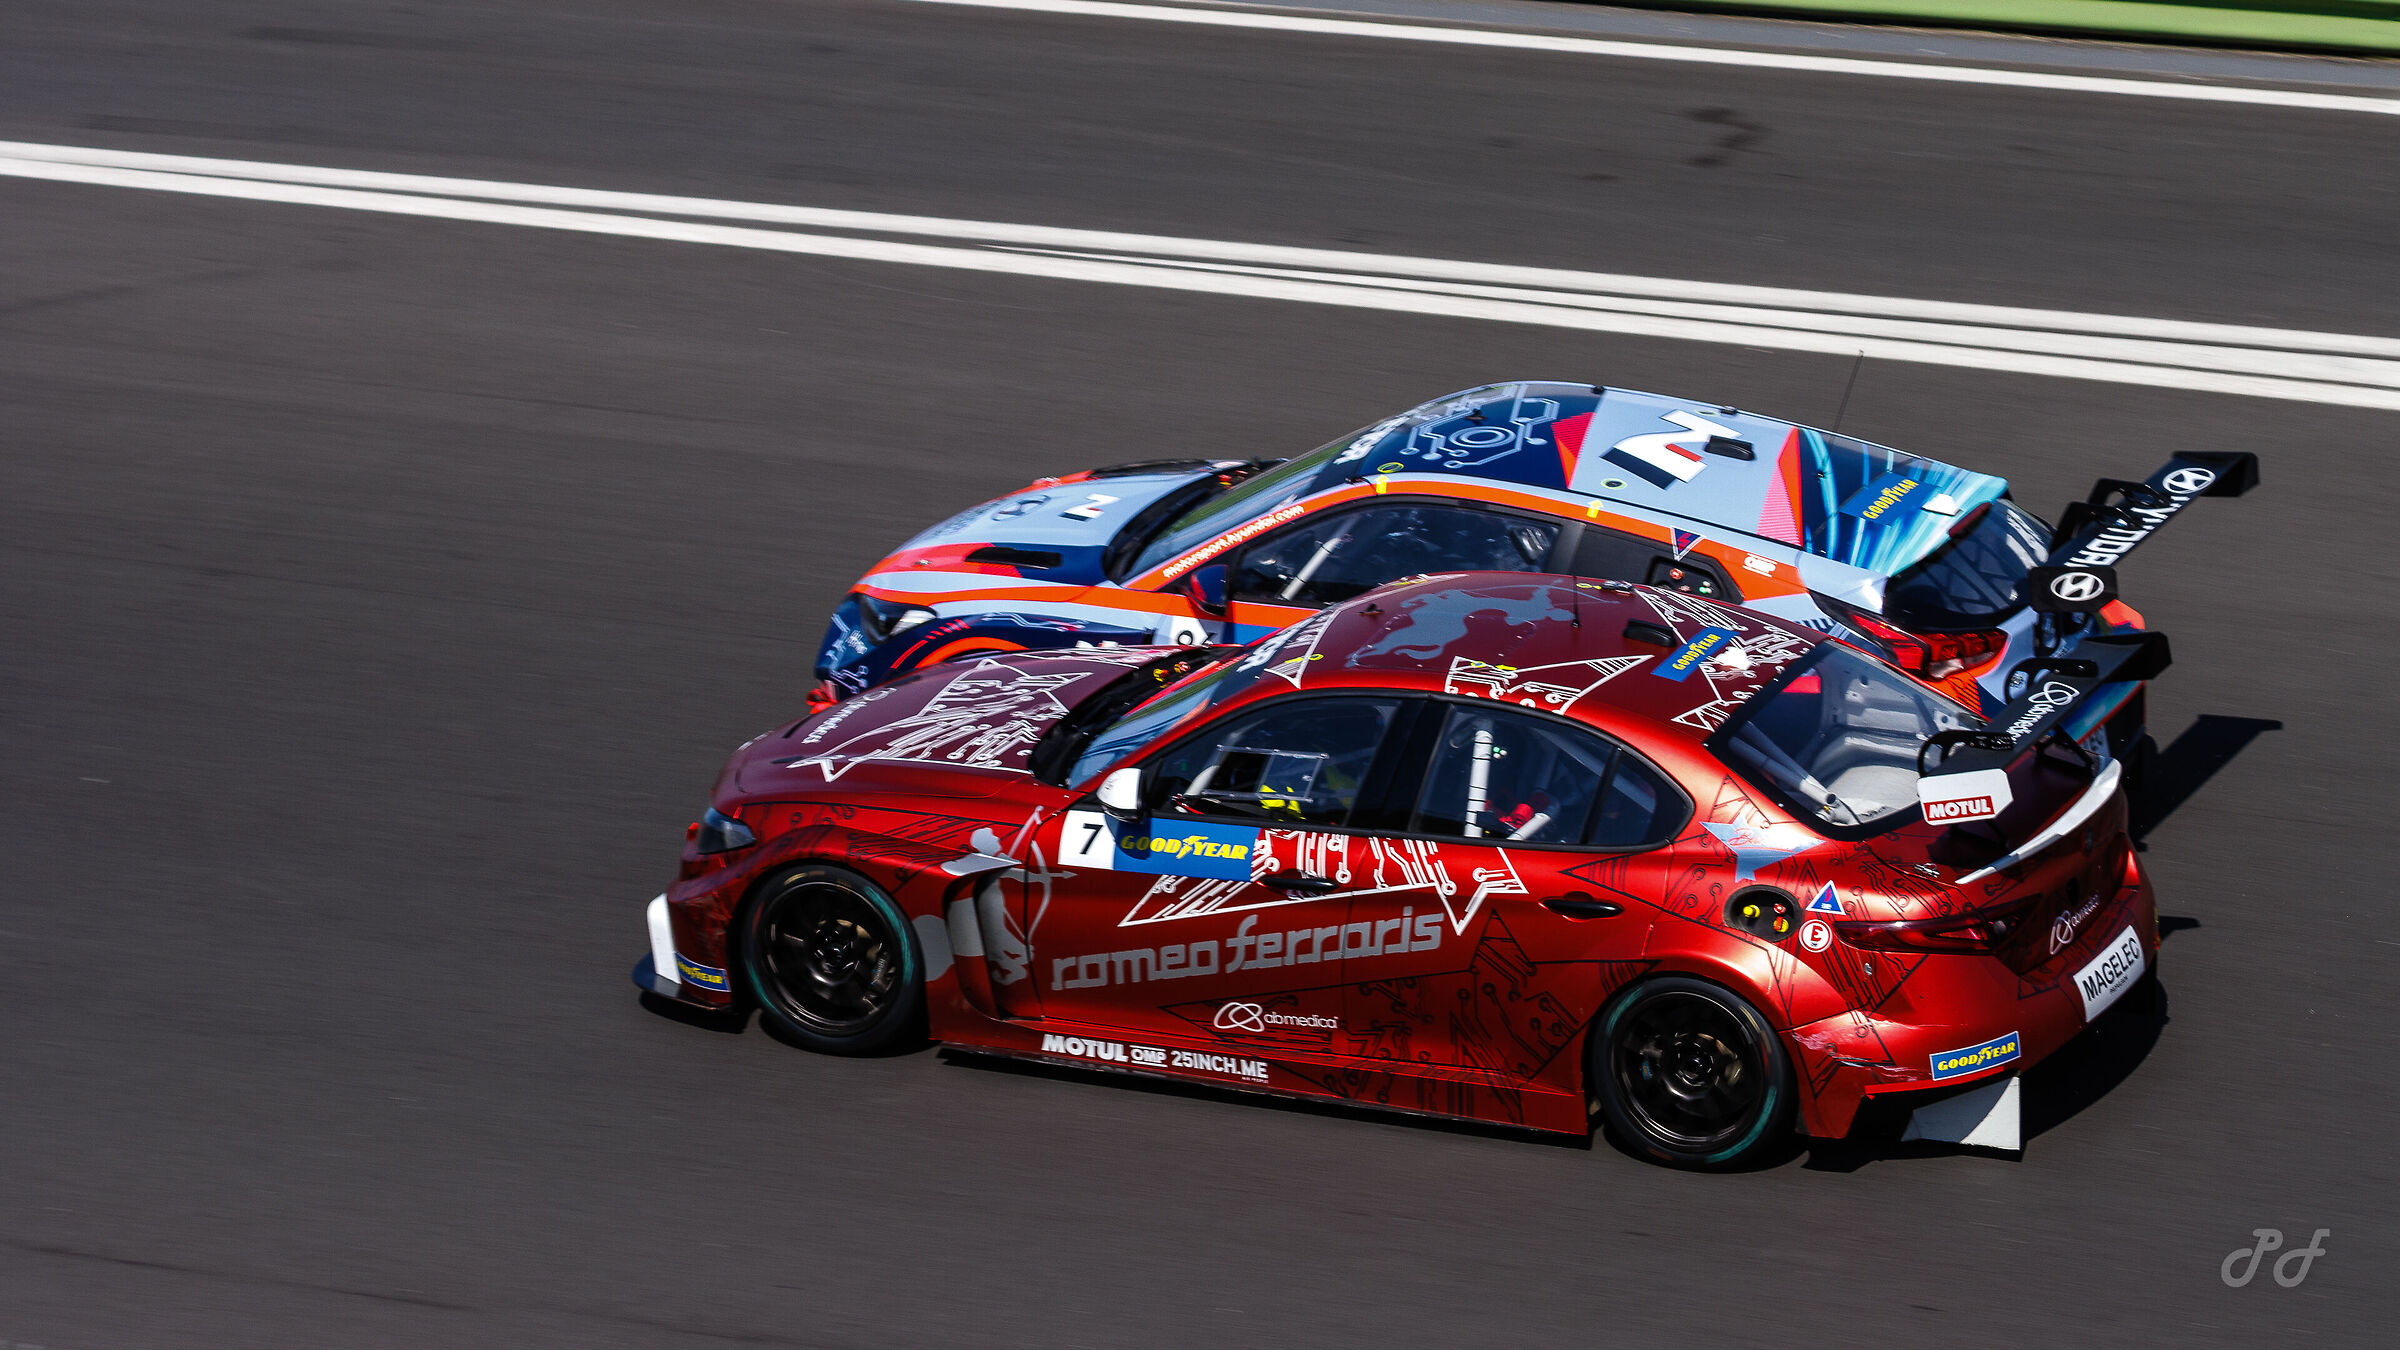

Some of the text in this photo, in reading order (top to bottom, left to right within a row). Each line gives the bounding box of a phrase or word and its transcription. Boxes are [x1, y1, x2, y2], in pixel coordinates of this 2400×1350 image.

[1863, 479, 1919, 519] GOODYEAR
[1672, 633, 1722, 671] GOODYEAR
[2006, 703, 2056, 744] abmedi
[1929, 798, 1992, 819] MOTUL
[1080, 822, 1104, 855] 7
[1120, 835, 1249, 861] GOODYEAR
[1051, 906, 1444, 991] romeo ferraris
[1811, 925, 1823, 942] E
[2082, 937, 2140, 1002] MAGELEC
[1041, 1033, 1129, 1063] MOTUL
[1130, 1048, 1167, 1064] OMP
[1937, 1041, 2016, 1071] GOODYEAR
[1171, 1050, 1269, 1079] 25INCH.ME
